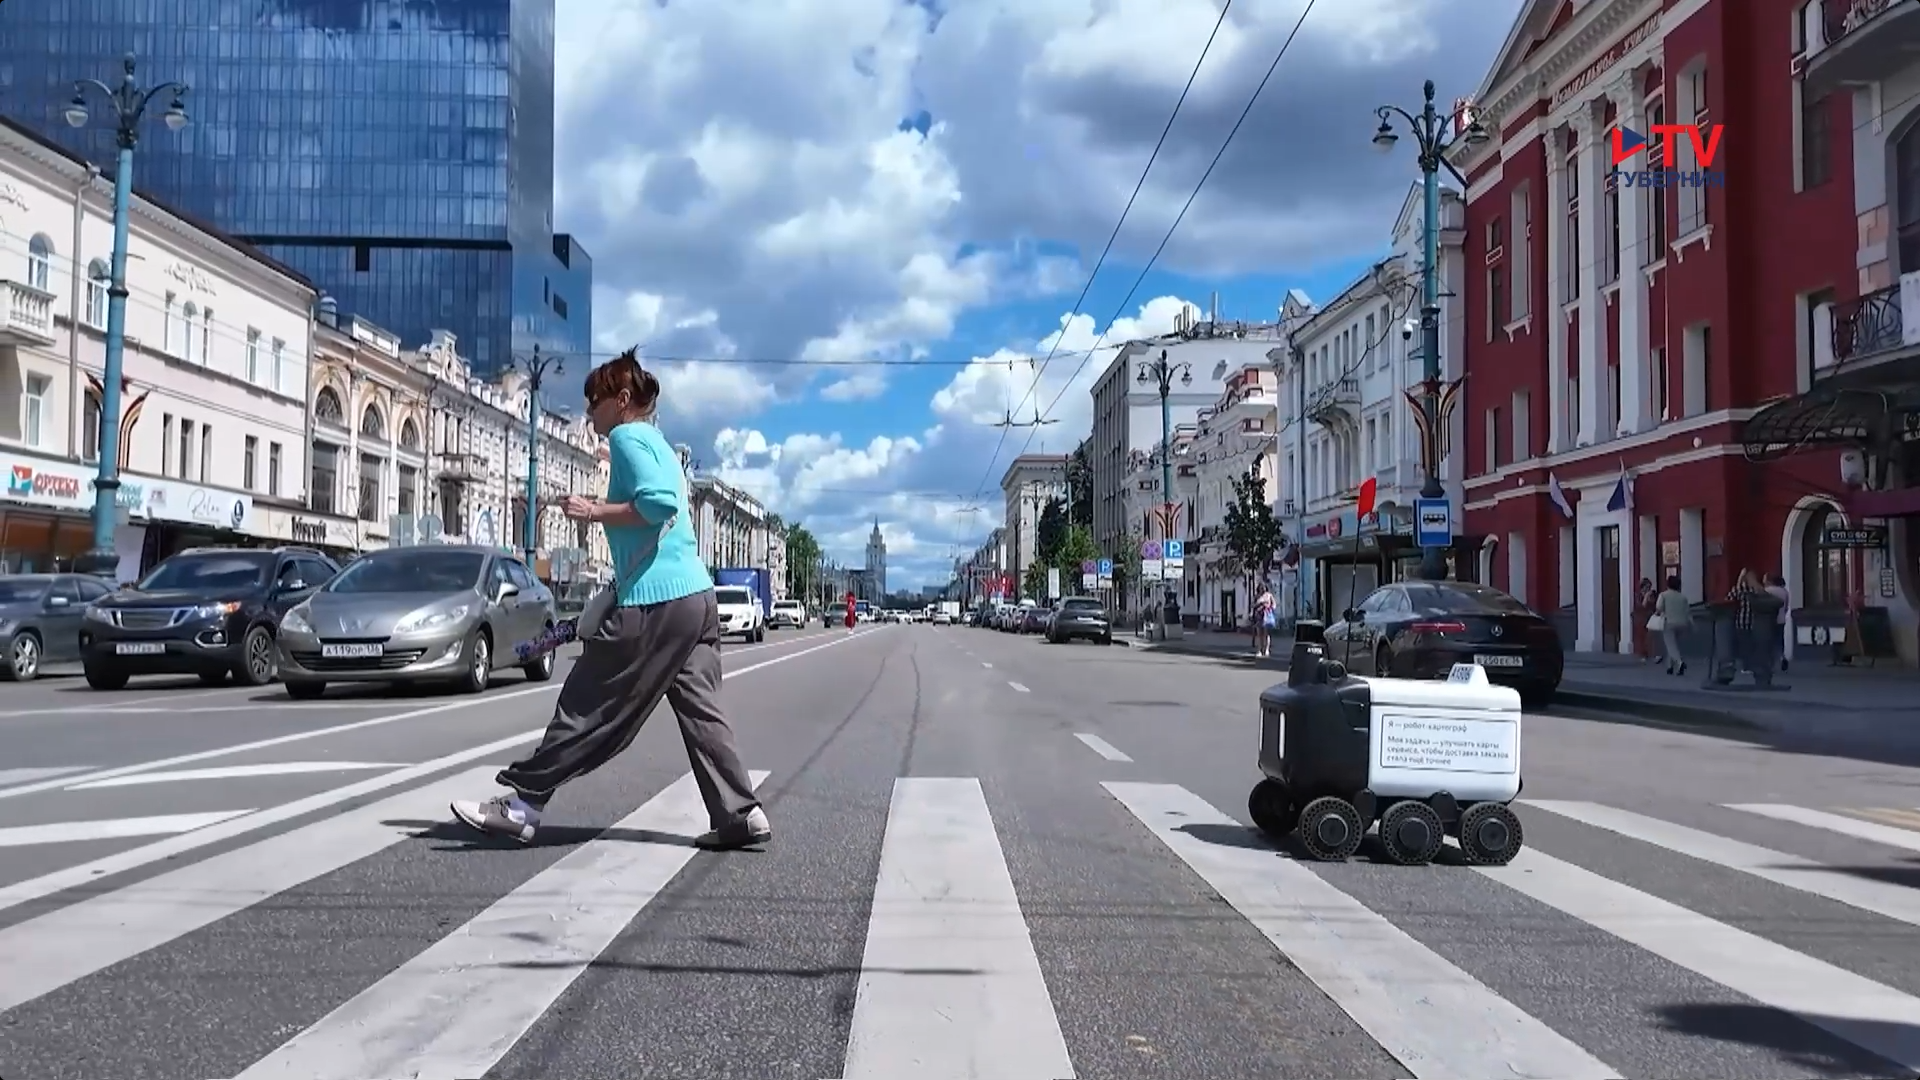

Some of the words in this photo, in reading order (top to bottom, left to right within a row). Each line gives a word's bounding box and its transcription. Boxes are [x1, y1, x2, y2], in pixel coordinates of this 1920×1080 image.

[1388, 736, 1403, 744] Моя
[1405, 738, 1430, 747] задача
[1441, 740, 1475, 749] улучшать
[1421, 747, 1443, 755] чтобы
[1444, 749, 1480, 758] доставка
[1387, 755, 1408, 763] стала
